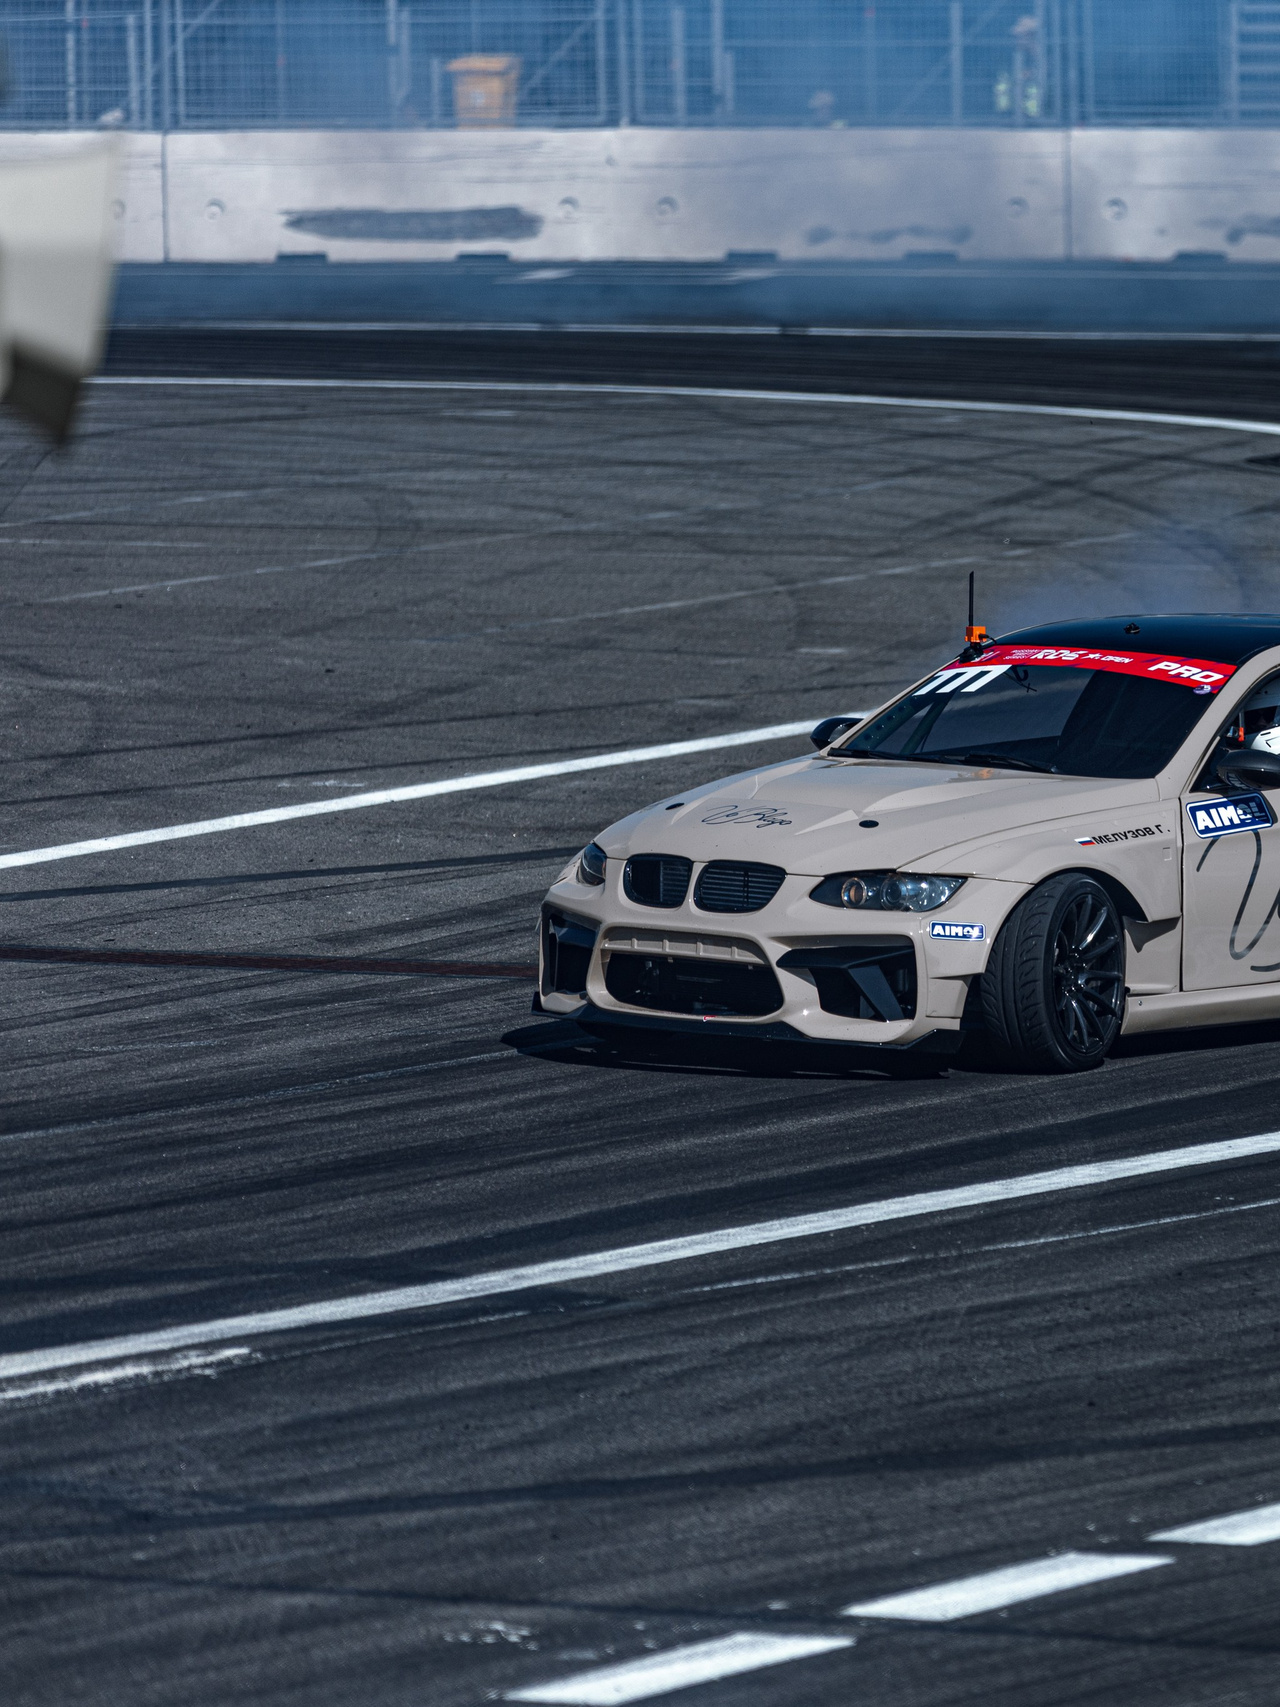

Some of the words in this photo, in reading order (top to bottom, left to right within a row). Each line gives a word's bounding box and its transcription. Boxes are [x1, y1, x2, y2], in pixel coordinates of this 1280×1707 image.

[1030, 649, 1089, 660] RDS
[1101, 655, 1134, 664] OPEN
[1147, 661, 1225, 683] PRO
[1195, 801, 1267, 830] AIMOL
[1092, 827, 1155, 845] МЕЛУЗОВ
[1156, 824, 1170, 834] Г.
